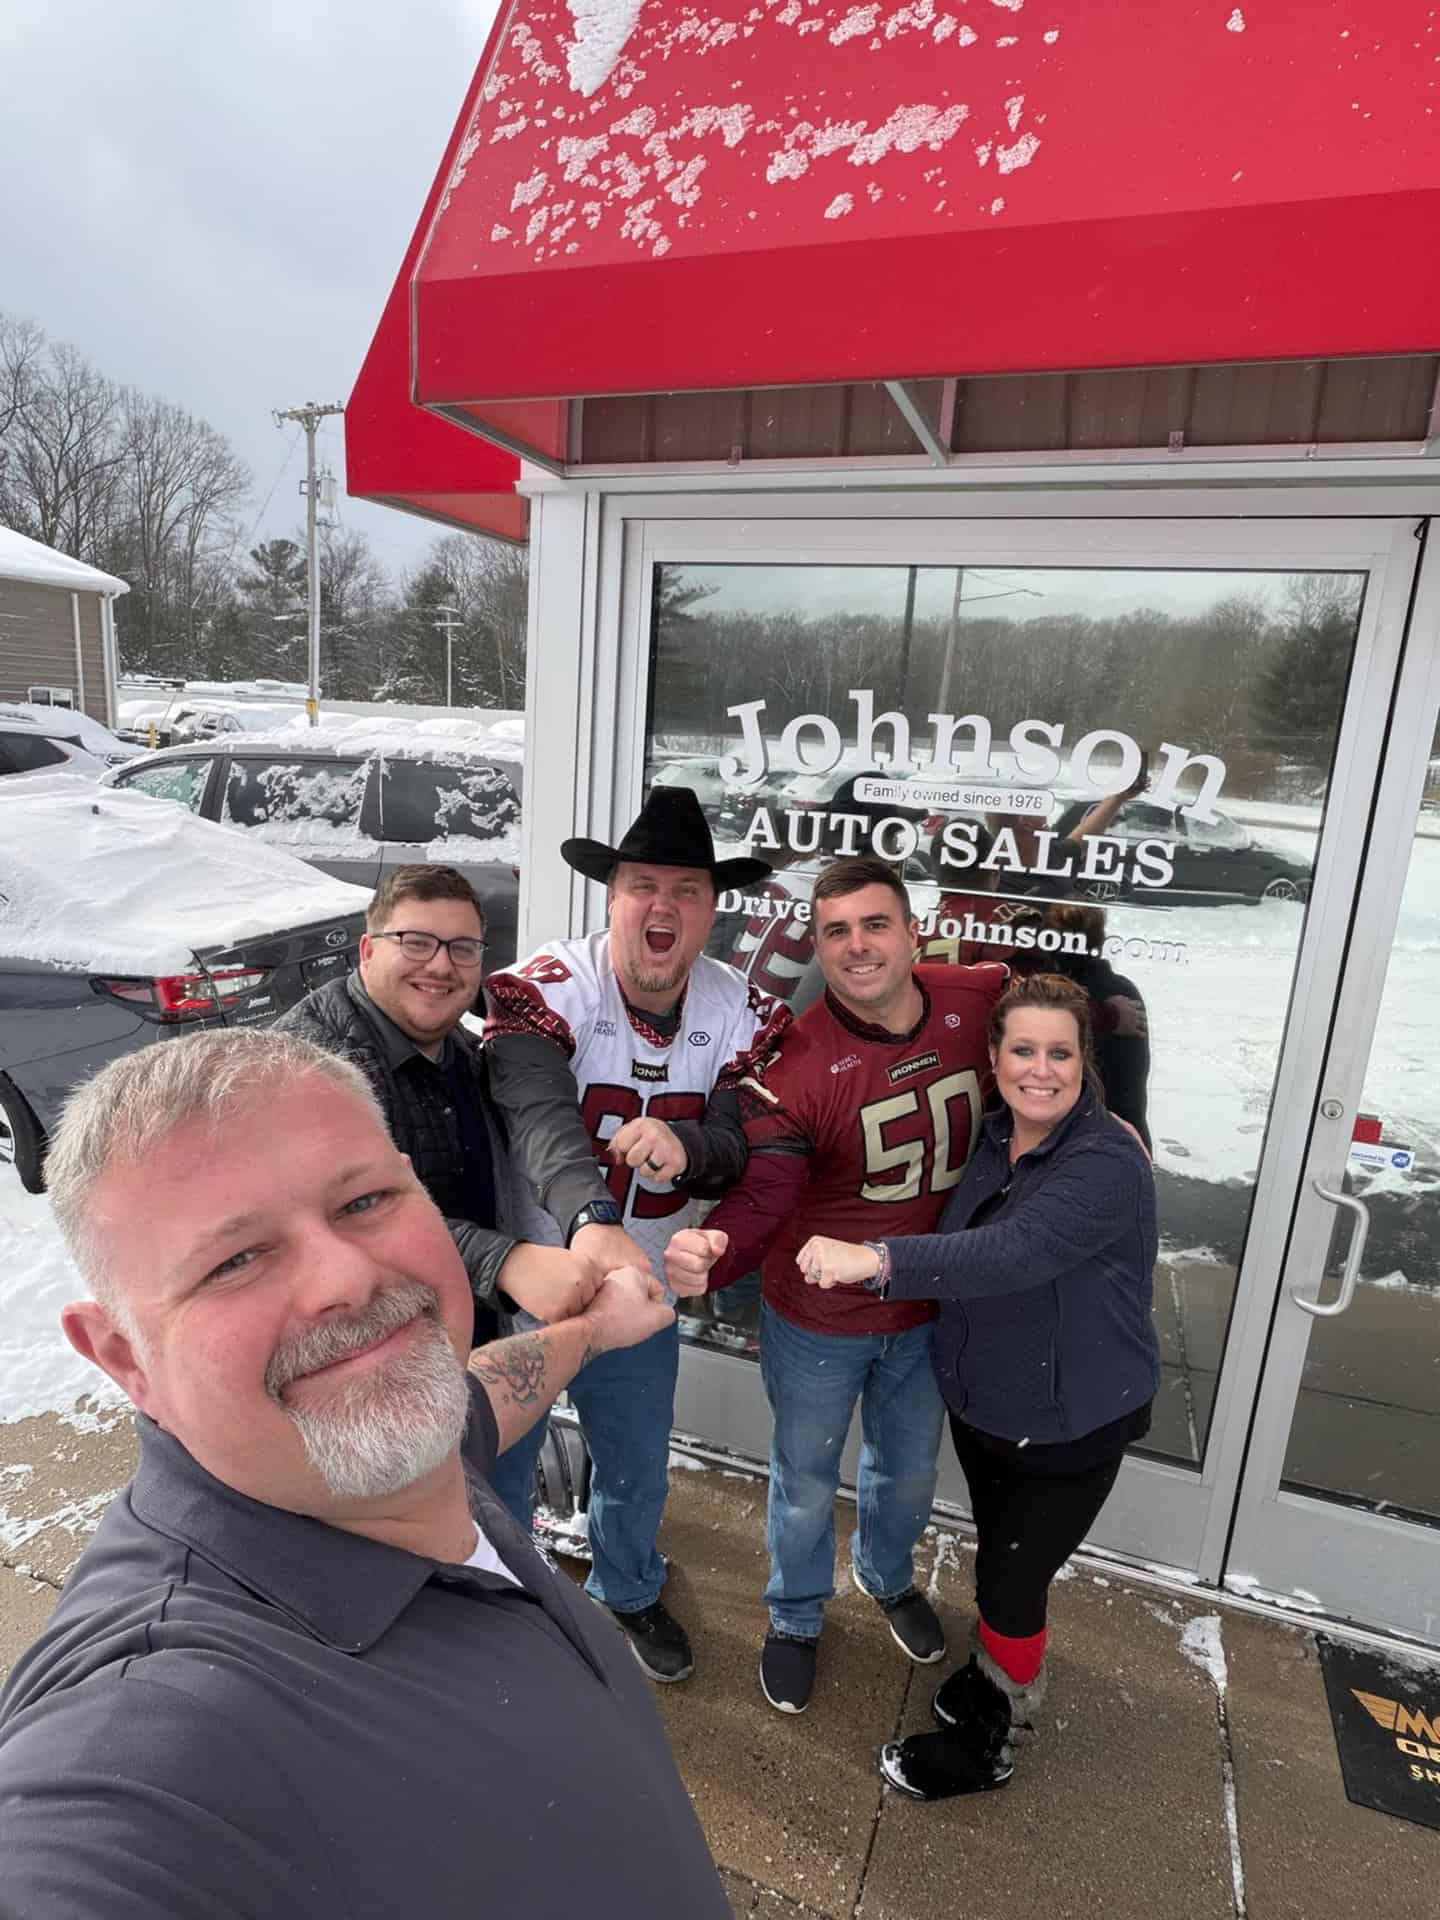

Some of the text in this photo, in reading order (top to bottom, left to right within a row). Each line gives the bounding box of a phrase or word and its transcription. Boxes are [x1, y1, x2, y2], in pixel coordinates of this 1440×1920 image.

[719, 689, 1227, 826] Johnson
[863, 783, 910, 801] Family
[912, 788, 960, 803] owned
[963, 792, 1001, 806] since
[743, 806, 1175, 888] AUTO SALES
[859, 1068, 984, 1202] 50
